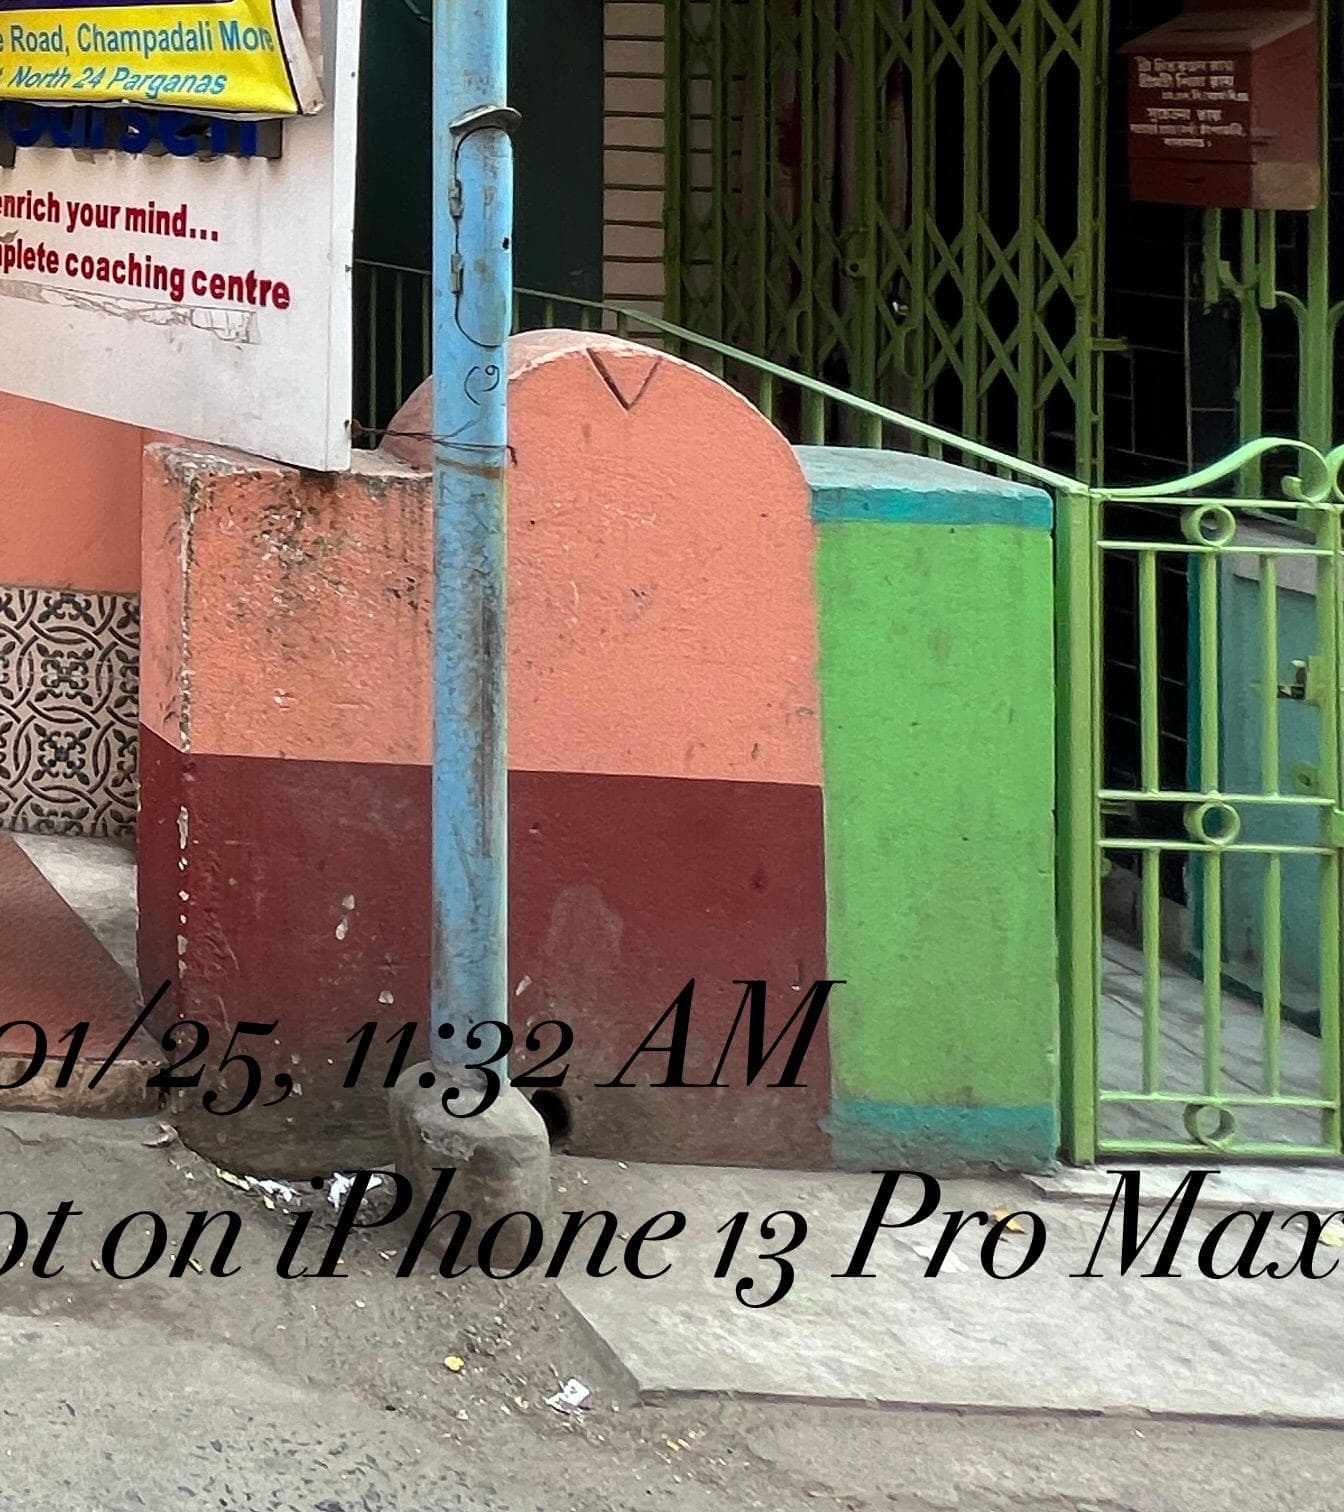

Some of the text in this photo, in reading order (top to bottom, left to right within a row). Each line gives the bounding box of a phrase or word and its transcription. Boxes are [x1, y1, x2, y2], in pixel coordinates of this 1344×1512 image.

[11, 23, 70, 57] Road,
[77, 21, 213, 63] Champadali
[7, 65, 74, 90] North
[78, 66, 105, 90] 24
[109, 68, 228, 99] Parganas
[66, 197, 122, 233] your
[124, 200, 220, 241] mind...
[65, 252, 186, 302] coaching
[191, 268, 291, 310] centre
